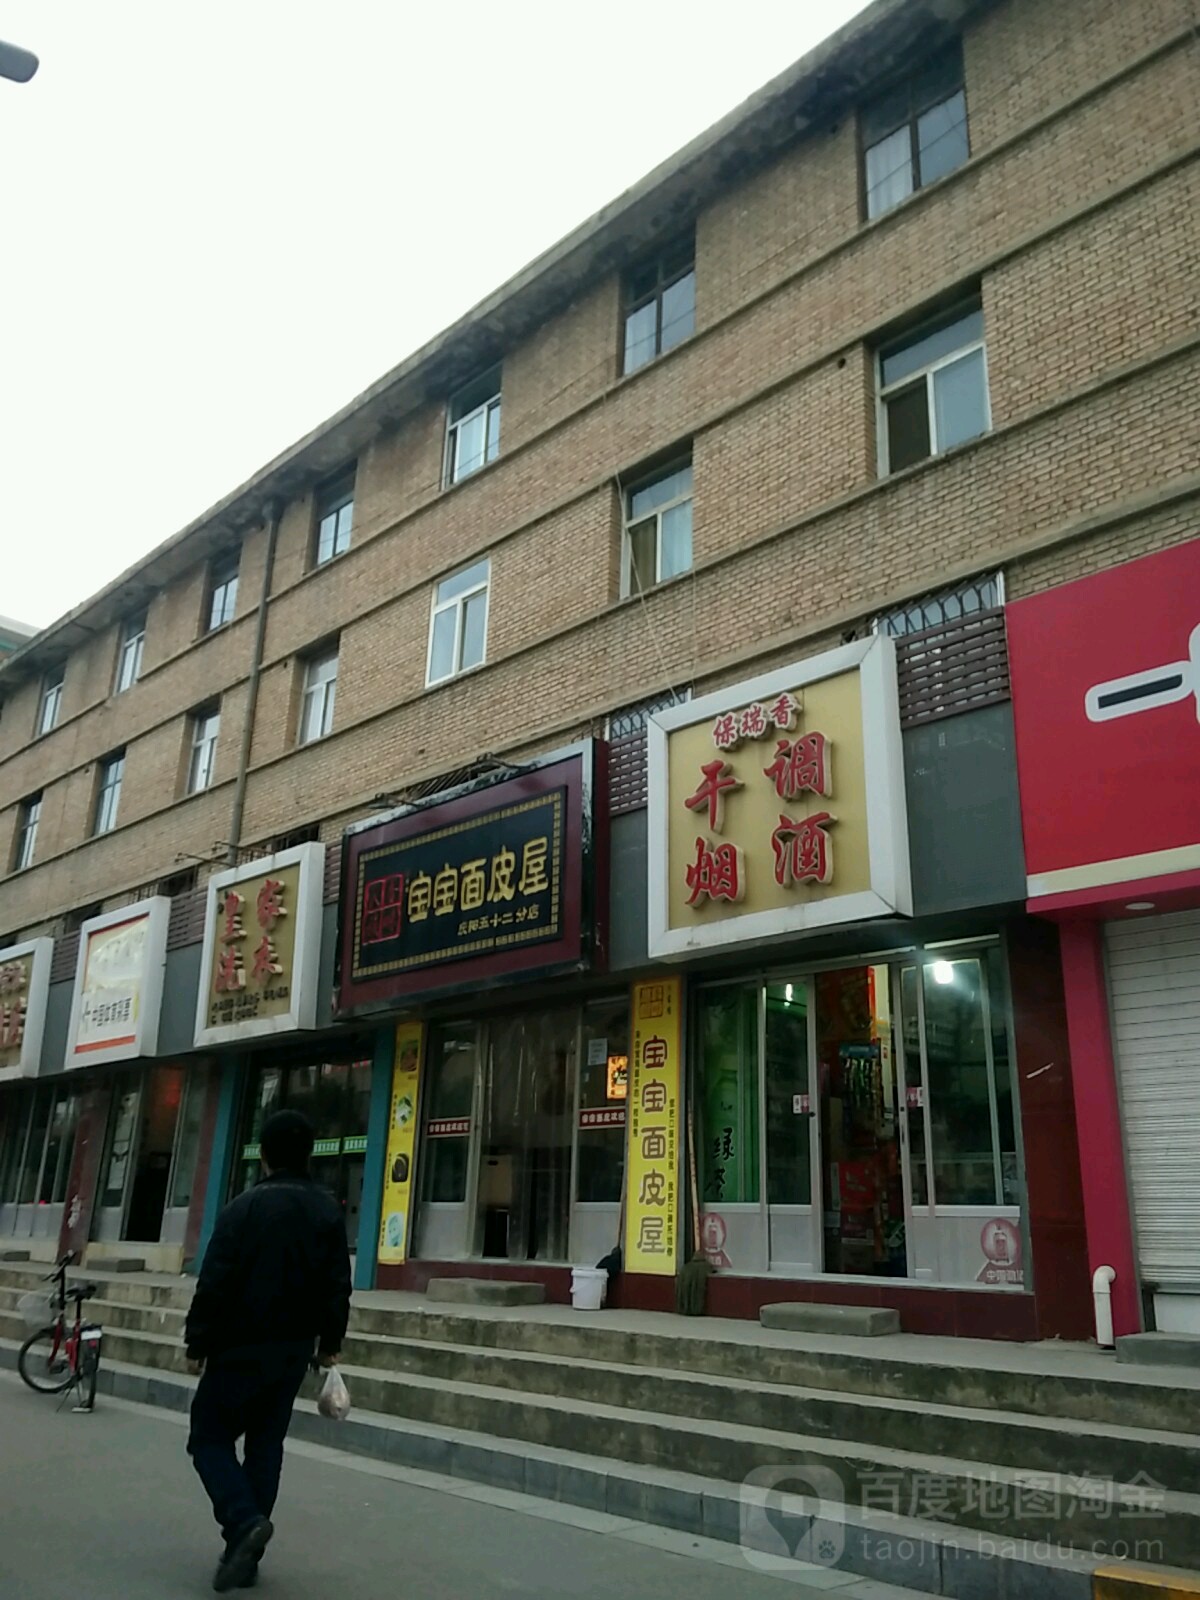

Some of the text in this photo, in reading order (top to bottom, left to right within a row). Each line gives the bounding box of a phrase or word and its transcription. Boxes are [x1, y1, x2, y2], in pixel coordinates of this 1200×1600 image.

[712, 692, 803, 752] 保瑞香
[407, 835, 549, 923] 宝宝面皮屋
[636, 1034, 668, 1254] 宝宝面皮屋
